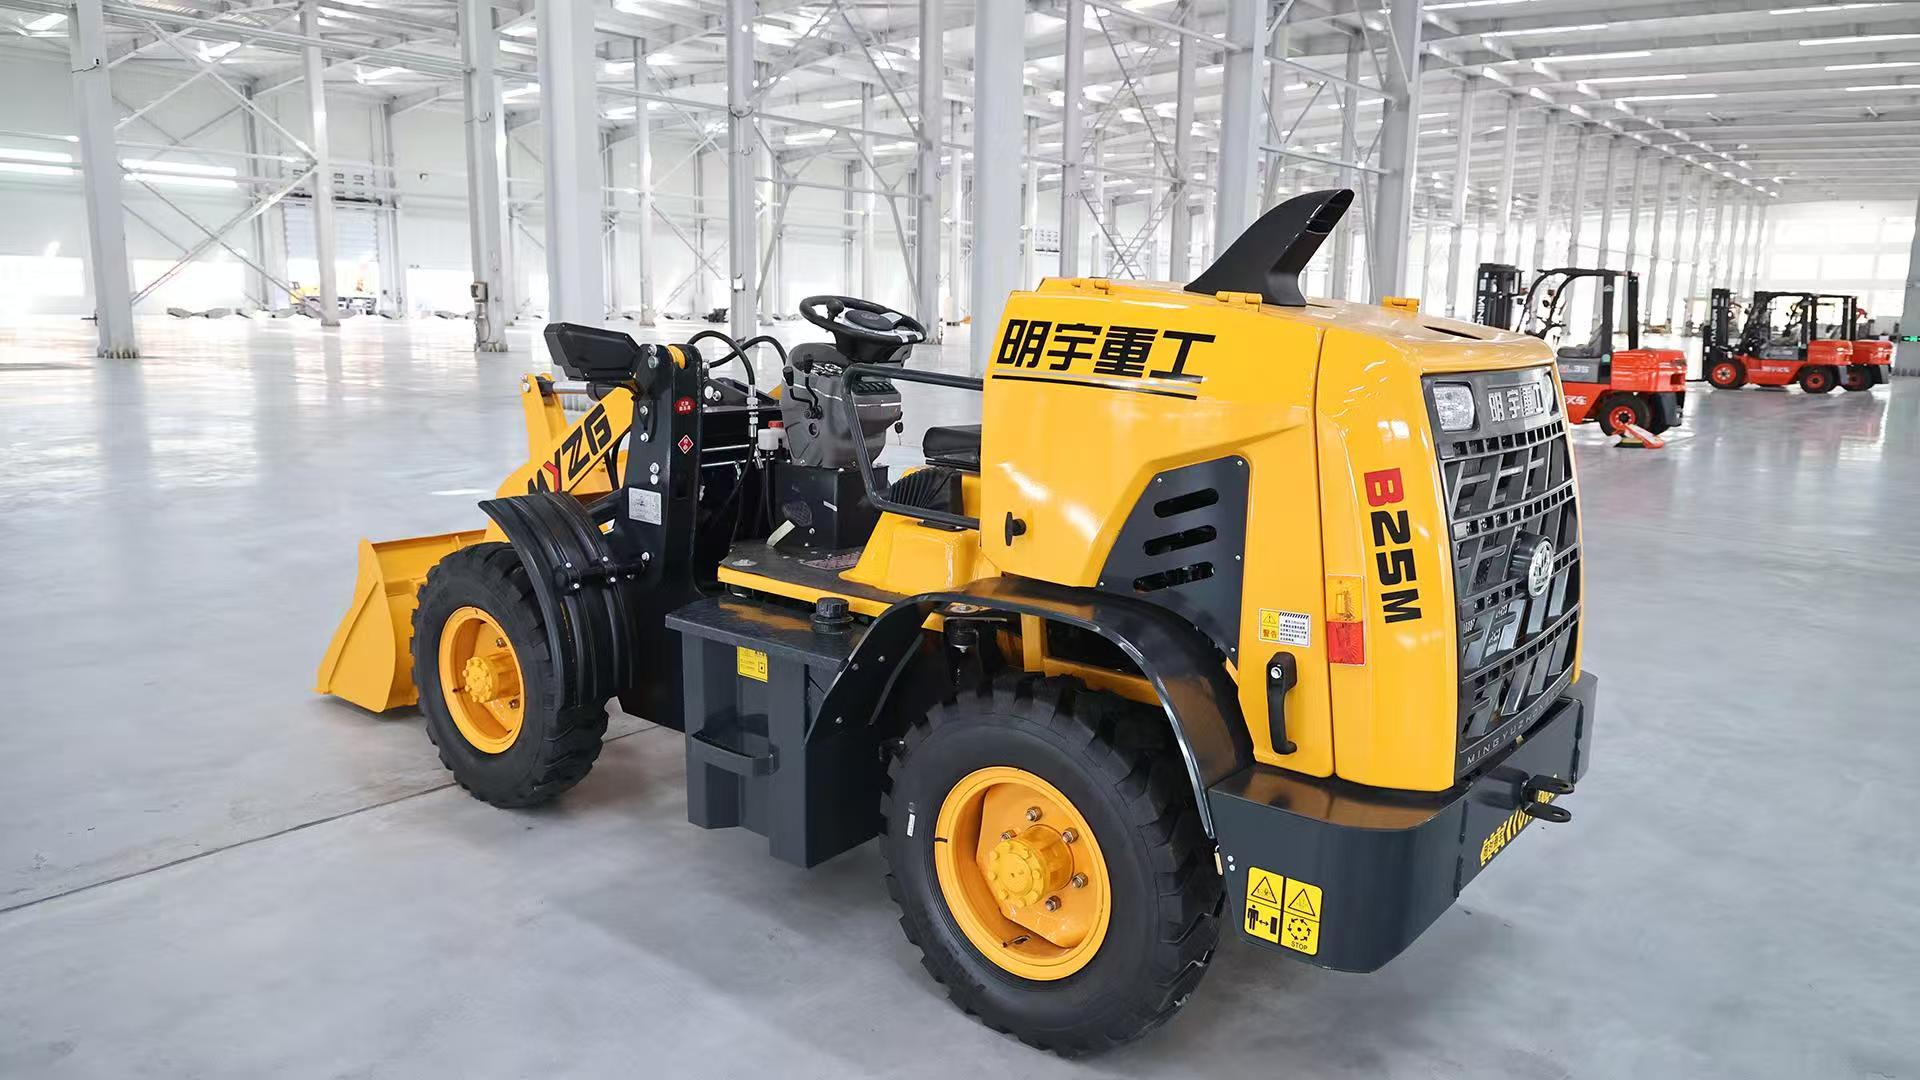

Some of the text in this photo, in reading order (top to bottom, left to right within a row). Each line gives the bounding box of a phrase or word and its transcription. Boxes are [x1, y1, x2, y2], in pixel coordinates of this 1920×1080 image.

[996, 319, 1216, 383] 明宇重工
[1488, 384, 1543, 422] 明宇重工
[1364, 467, 1422, 624] B25M
[1291, 941, 1308, 951] STOP
